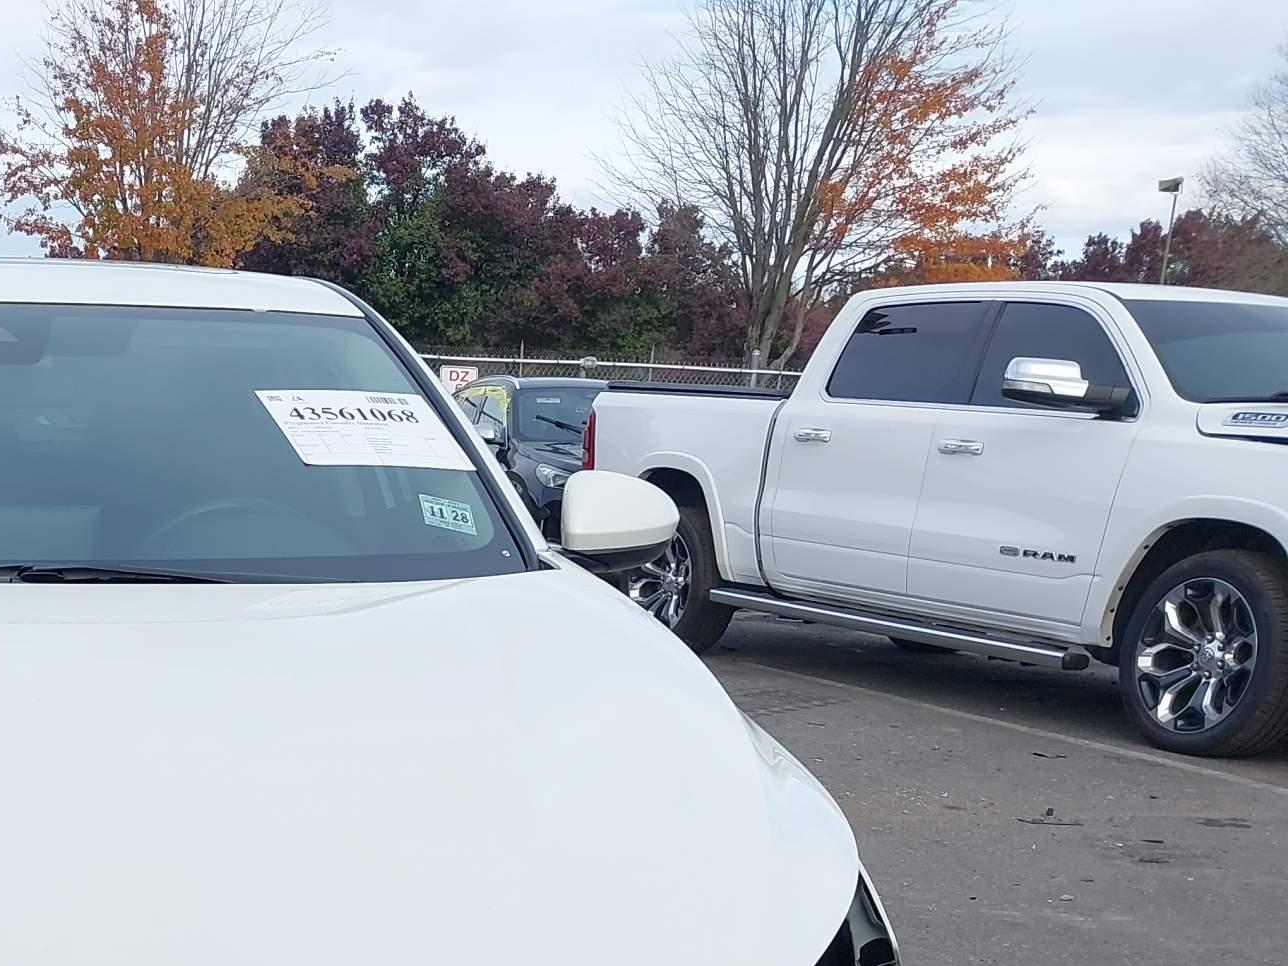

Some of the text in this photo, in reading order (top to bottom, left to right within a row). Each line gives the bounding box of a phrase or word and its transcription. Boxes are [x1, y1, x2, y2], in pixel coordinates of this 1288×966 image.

[449, 370, 470, 383] DZ
[289, 406, 420, 424] 43561068
[1236, 413, 1287, 422] 1500
[428, 505, 447, 520] 11
[452, 510, 469, 524] 28
[1022, 548, 1077, 564] RAM
